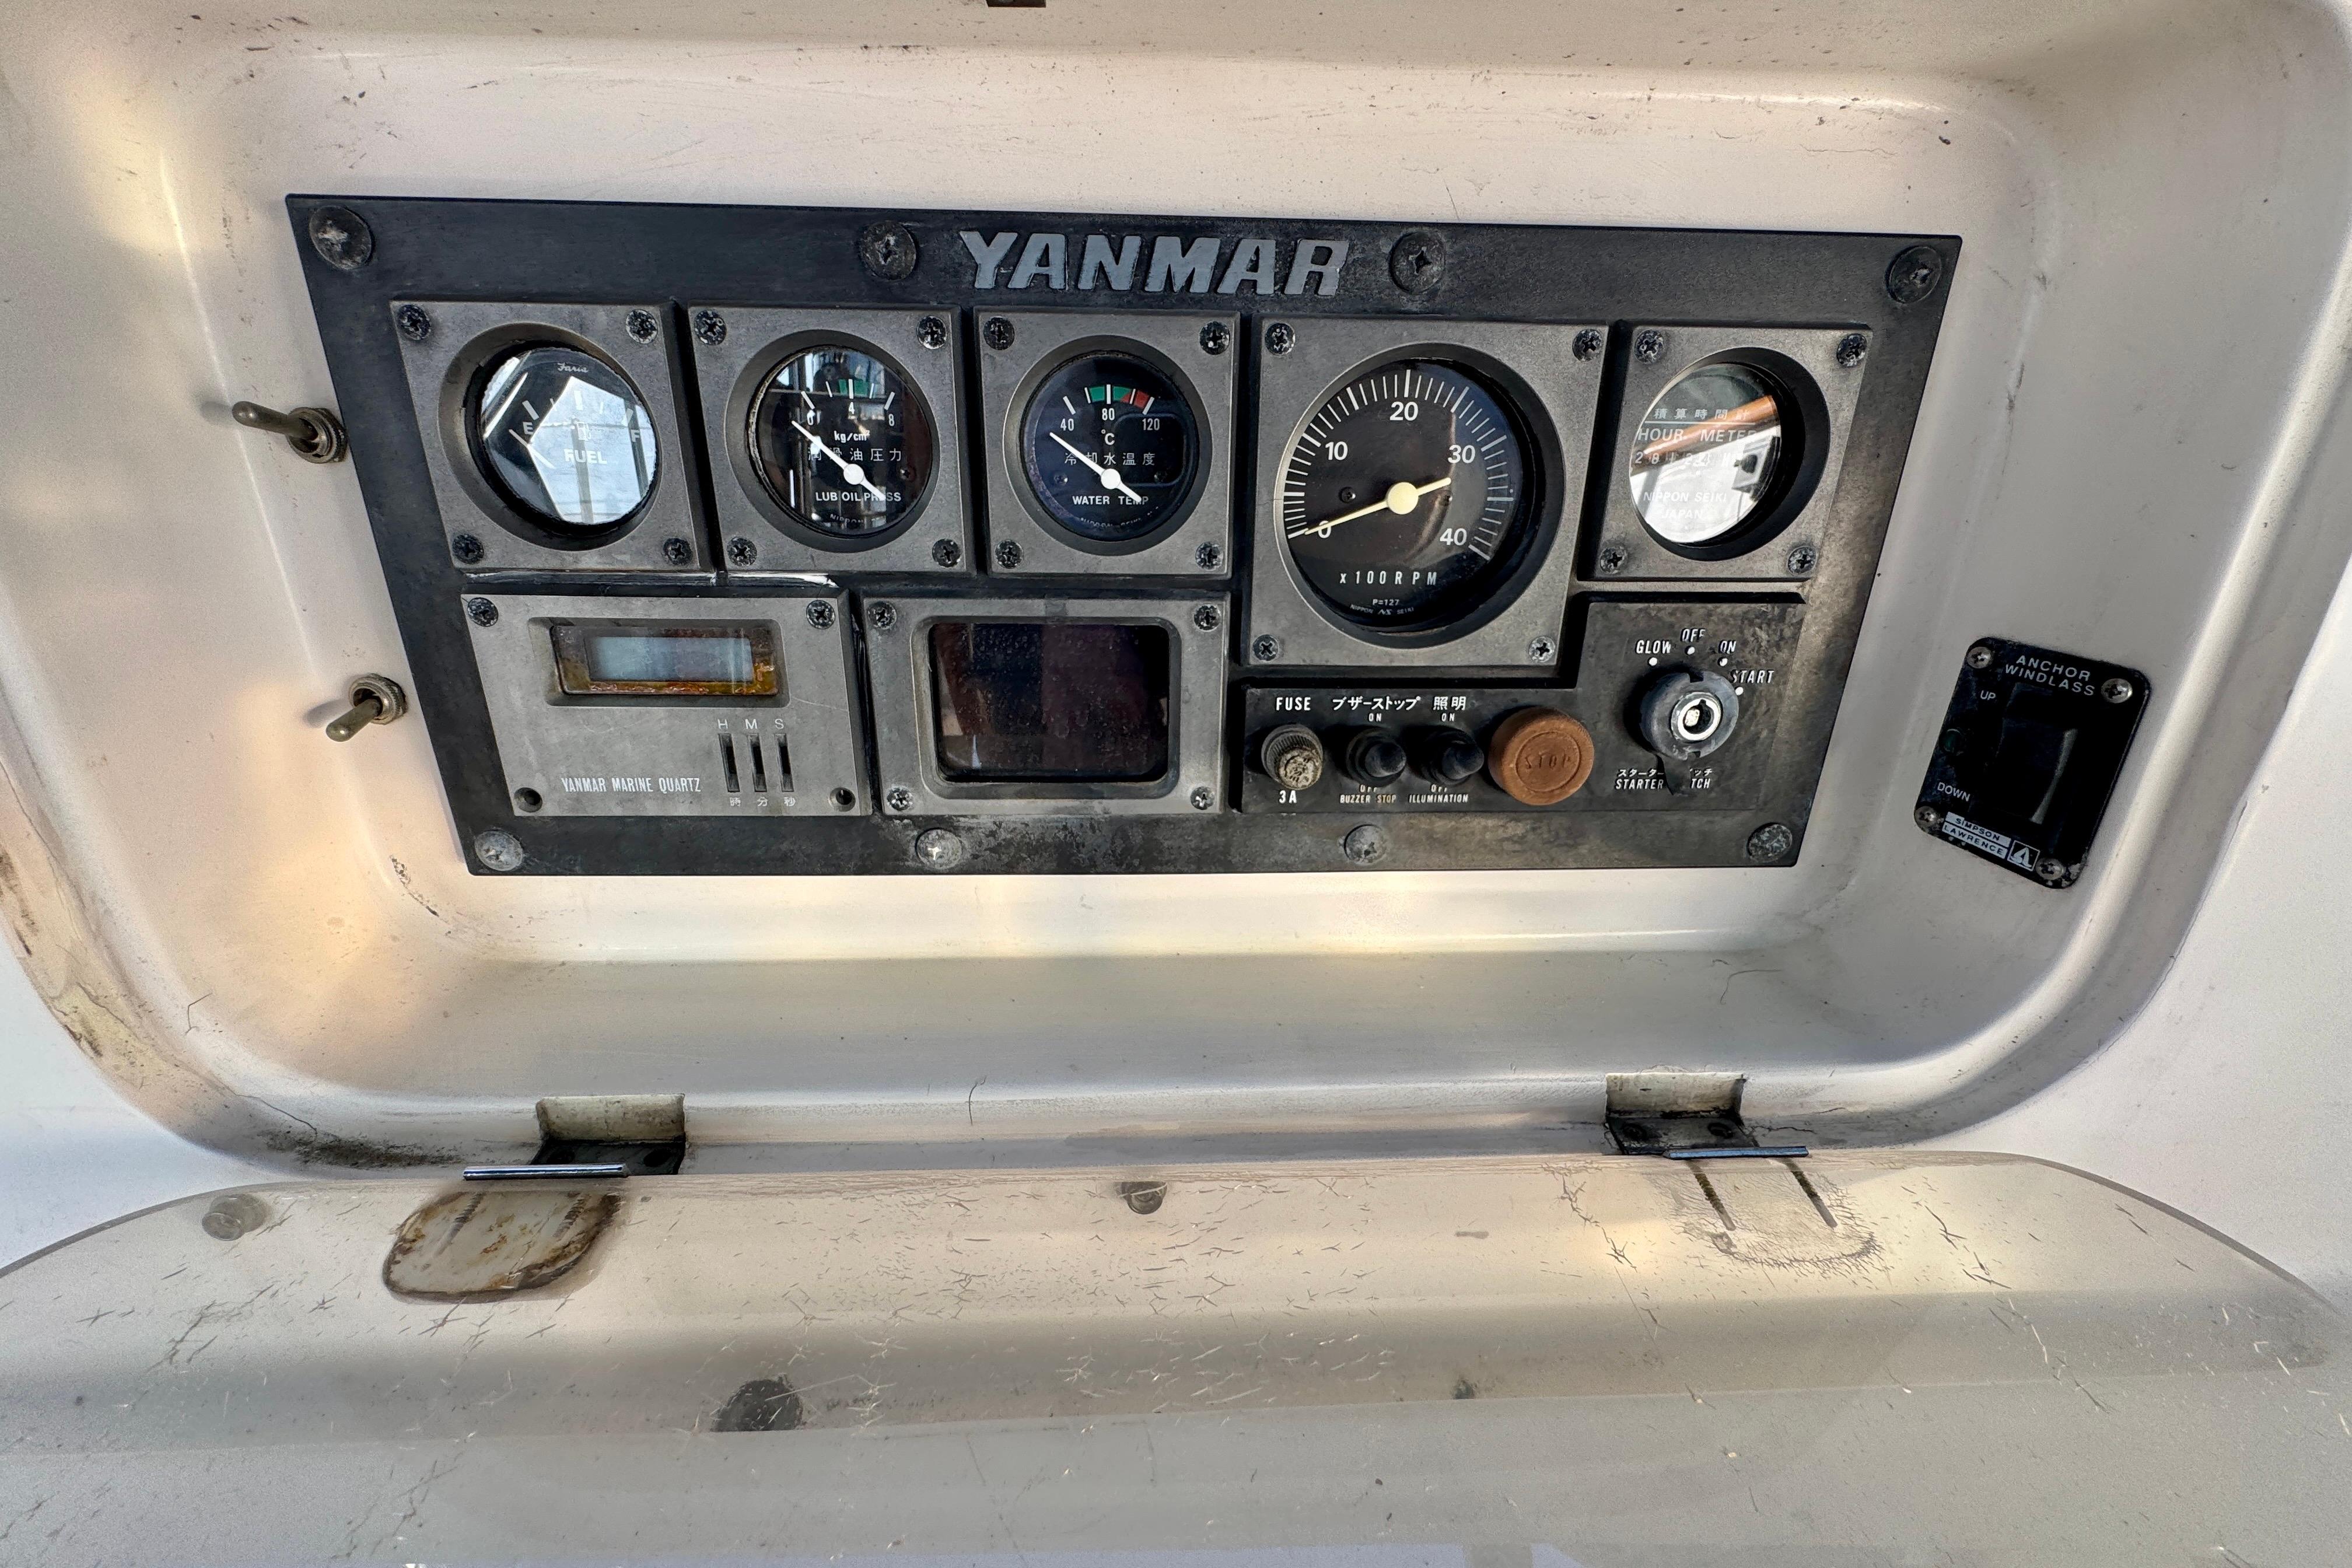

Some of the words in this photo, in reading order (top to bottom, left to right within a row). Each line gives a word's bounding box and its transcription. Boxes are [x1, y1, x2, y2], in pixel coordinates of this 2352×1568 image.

[960, 231, 1349, 296] YANMAR
[848, 402, 855, 415] 4
[1102, 408, 1115, 421] 80
[1390, 402, 1418, 421] 20
[888, 414, 895, 426] 8
[1060, 418, 1074, 431] 40
[1142, 418, 1160, 431] 120
[523, 422, 533, 435] E
[1638, 428, 1684, 441] HOUR
[631, 429, 640, 442] F
[564, 449, 607, 464] FUEL
[1325, 442, 1348, 460] 10
[1448, 445, 1476, 464] 30
[816, 492, 838, 501] LUB
[842, 492, 861, 501] OIL
[1072, 496, 1110, 505] WATER
[1643, 492, 1689, 502] NIPPON
[1318, 521, 1332, 538] 0
[1440, 528, 1467, 546] 40
[1350, 604, 1373, 614] NIPPON
[1682, 629, 1706, 642] OFF
[1636, 640, 1671, 654] GLOW
[1720, 640, 1737, 654] ON
[2017, 654, 2091, 681] ANCHOR
[1731, 670, 1774, 684] START
[2005, 664, 2095, 696] WINDLASS
[1980, 690, 1996, 701] UP
[1276, 697, 1311, 711] FUSE
[1332, 696, 1421, 710] ブザーストップ
[1433, 696, 1466, 711] 照明
[718, 719, 728, 729] H
[745, 719, 758, 729] M
[775, 718, 784, 729] S
[1368, 713, 1382, 722] ON
[1441, 713, 1455, 722] ON
[1525, 752, 1571, 769] STOP
[561, 778, 606, 792] YANMAR
[612, 778, 652, 792] MARINE
[659, 778, 701, 792] QUARTZ
[1615, 779, 1664, 789] STARTER
[1279, 790, 1297, 803] 3A
[1340, 794, 1370, 803] BUZZER
[1377, 794, 1396, 803] STOP
[1409, 794, 1468, 803] ILLUMINATION
[1937, 782, 1970, 802] DOWN
[730, 797, 741, 806] 時
[757, 797, 768, 806] 分
[784, 797, 796, 806] 秒
[1956, 818, 2000, 841] SIMPSON
[1944, 824, 2004, 855] LAWRENCE
